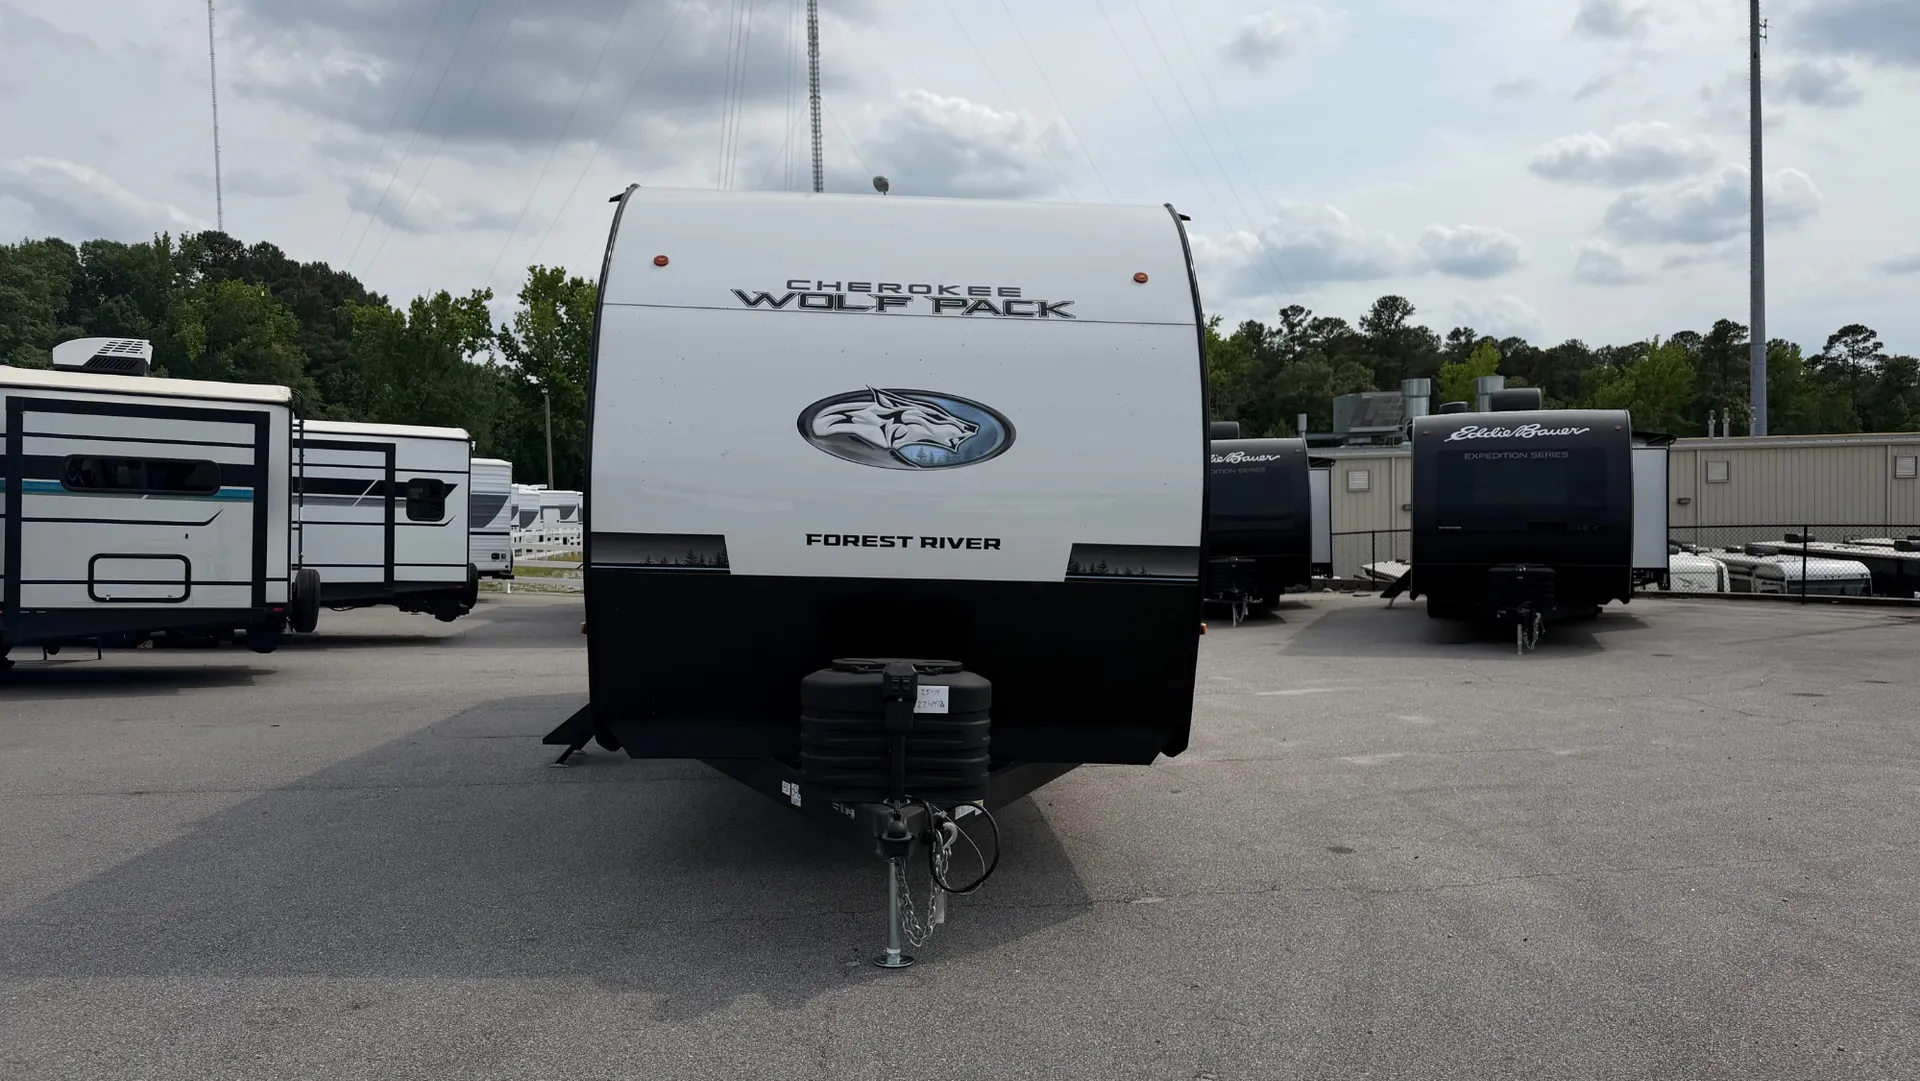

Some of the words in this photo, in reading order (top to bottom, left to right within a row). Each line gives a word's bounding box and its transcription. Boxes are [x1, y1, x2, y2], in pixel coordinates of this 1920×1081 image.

[786, 279, 1022, 298] CHEROKEE
[730, 288, 914, 313] WOLF
[924, 295, 1077, 319] PACK
[1444, 425, 1513, 442] Eddie
[1514, 423, 1590, 439] Bauer
[1226, 451, 1281, 464] Bauer
[1464, 452, 1528, 460] EXPEDITION
[1531, 451, 1569, 459] SERIES
[805, 533, 913, 548] FOREST
[920, 536, 1001, 550] RIVER
